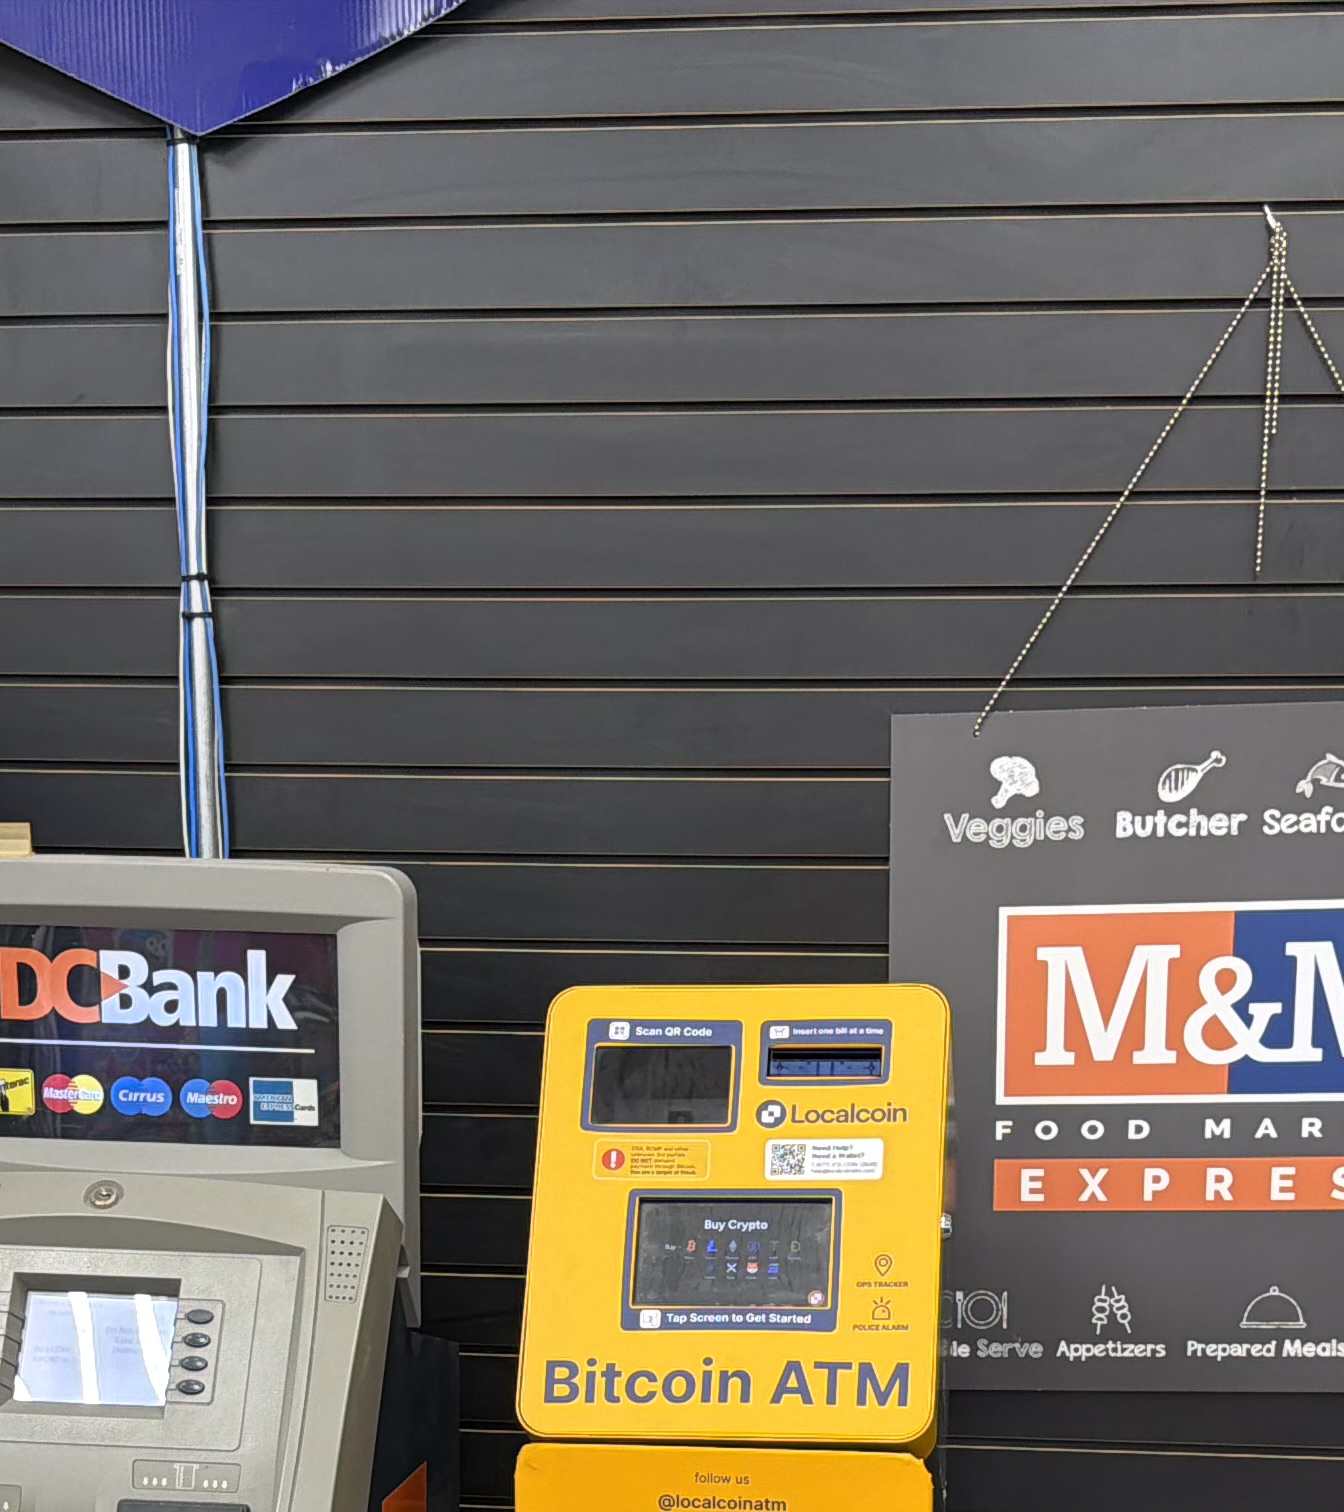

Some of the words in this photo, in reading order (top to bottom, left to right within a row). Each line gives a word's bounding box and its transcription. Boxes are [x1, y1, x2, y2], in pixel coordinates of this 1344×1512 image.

[944, 811, 1085, 849] Veggies
[1115, 808, 1248, 840] Butcher
[635, 1026, 662, 1037] Scan
[664, 1026, 682, 1038] QR
[683, 1026, 713, 1037] Code
[792, 1027, 817, 1036] Insert
[835, 1027, 848, 1036] bill
[848, 1028, 858, 1036] at
[865, 1027, 885, 1036] time
[43, 1085, 105, 1103] MasterCard
[118, 1088, 166, 1104] Cirrus
[186, 1091, 239, 1108] Maestro
[252, 1094, 294, 1103] AMERICAN
[260, 1102, 294, 1111] EXPRESS
[294, 1103, 317, 1113] Cards
[791, 1102, 908, 1125] Localcoin
[994, 1119, 1152, 1142] FOOD
[704, 1219, 726, 1232] Buy
[727, 1219, 769, 1232] Crypto
[666, 1313, 687, 1324] Tap
[689, 1313, 729, 1323] Screen
[731, 1313, 743, 1323] to
[745, 1313, 766, 1324] Get
[768, 1313, 812, 1324] Started
[976, 1336, 1044, 1360] Serve
[1056, 1339, 1167, 1363] Appetizers
[1186, 1338, 1278, 1362] Prepared
[543, 1356, 753, 1405] Bitcoin
[769, 1360, 911, 1408] ATM
[694, 1471, 731, 1485] follow
[735, 1474, 750, 1486] us
[658, 1494, 788, 1512] @localcoinatm
